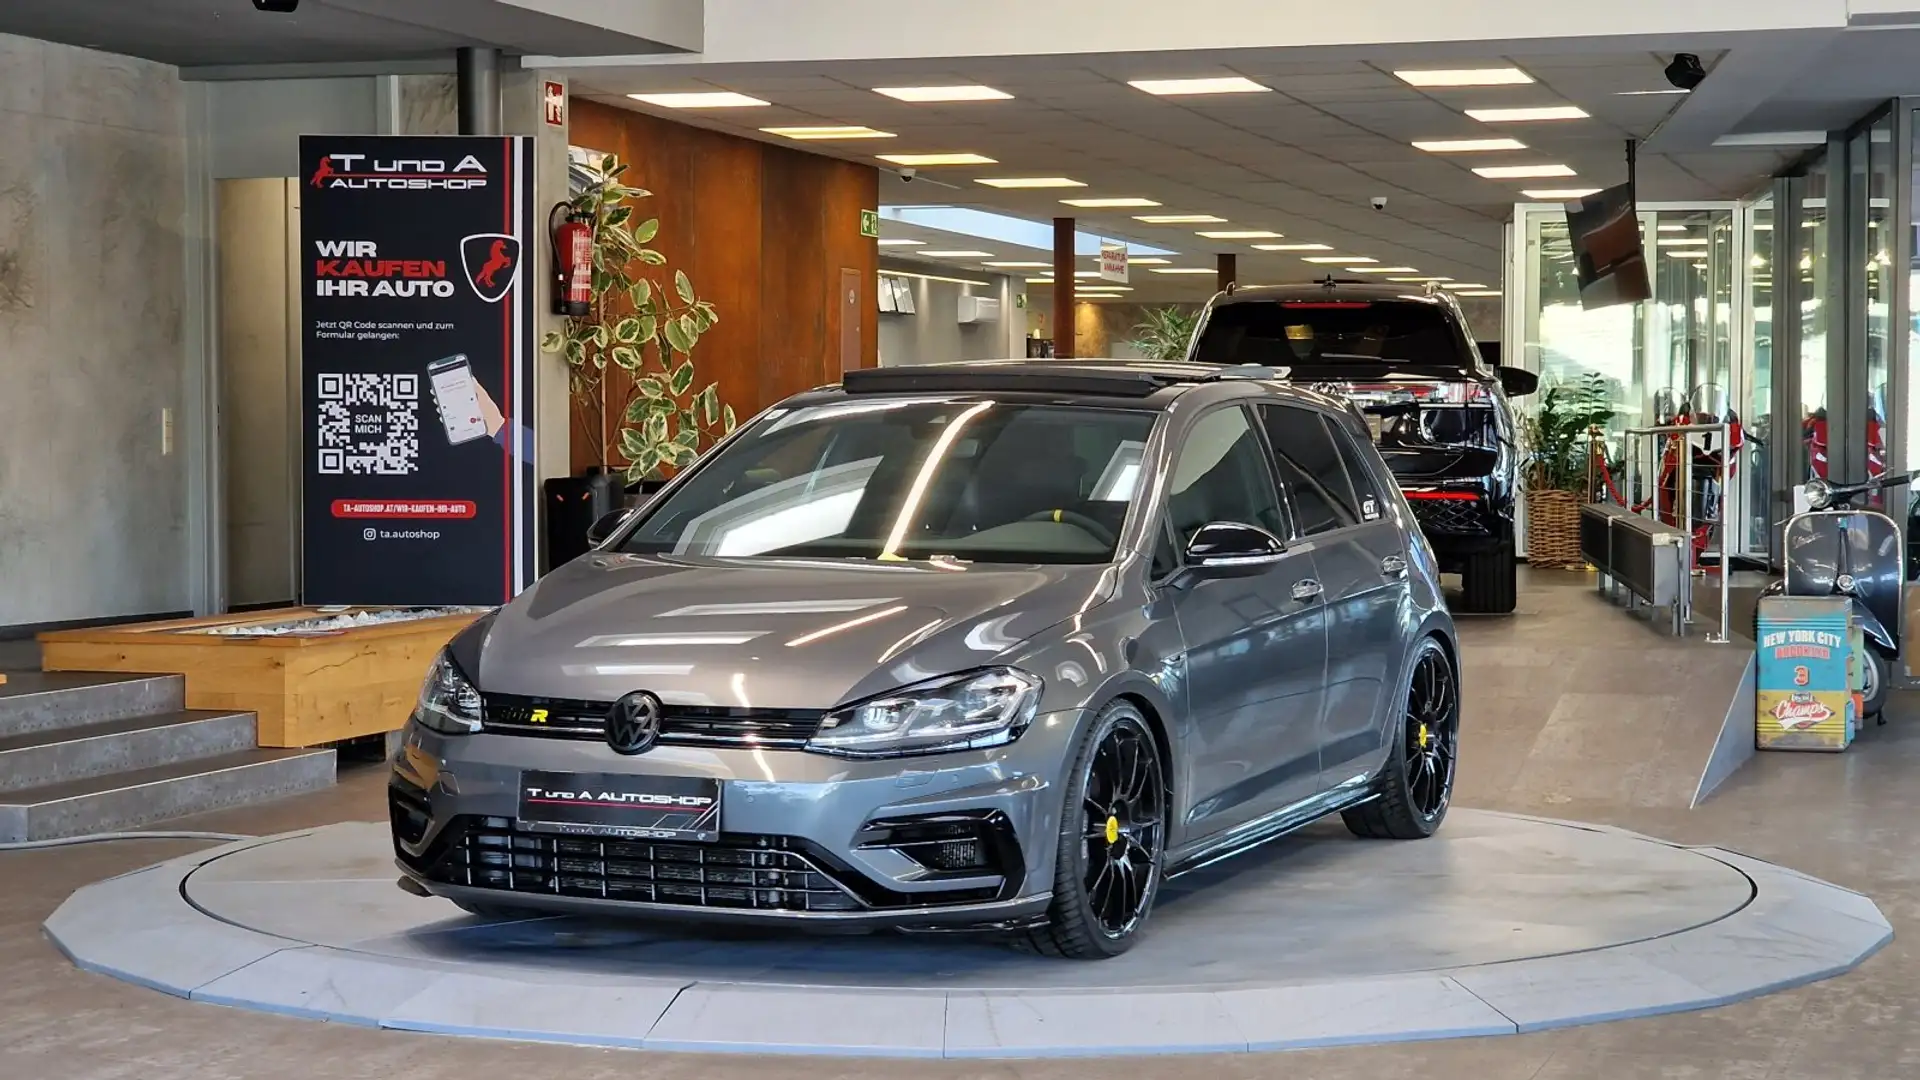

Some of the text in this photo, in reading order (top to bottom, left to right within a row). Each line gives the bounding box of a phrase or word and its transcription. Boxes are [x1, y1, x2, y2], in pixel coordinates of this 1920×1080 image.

[329, 153, 366, 172] T
[452, 154, 488, 173] A
[329, 178, 488, 190] AUTOSHOP
[315, 240, 377, 258] WIR
[316, 260, 446, 278] KAUFEN
[316, 280, 455, 298] IHR AUTO
[315, 320, 454, 330] Jetzt QR Code scannen und zum
[316, 330, 400, 341] Formular gelangen:
[355, 414, 382, 424] SCAN
[355, 424, 382, 434] MICH
[379, 529, 441, 540] ta.autoshop
[1763, 630, 1842, 648] NEW YORK CITY
[1794, 665, 1809, 686] 3
[530, 708, 549, 723] R
[1775, 699, 1828, 721] Champs
[527, 787, 542, 797] T
[578, 790, 593, 800] A
[599, 791, 712, 806] AUTOSHOP
[599, 827, 677, 838] AUTOSHOP
